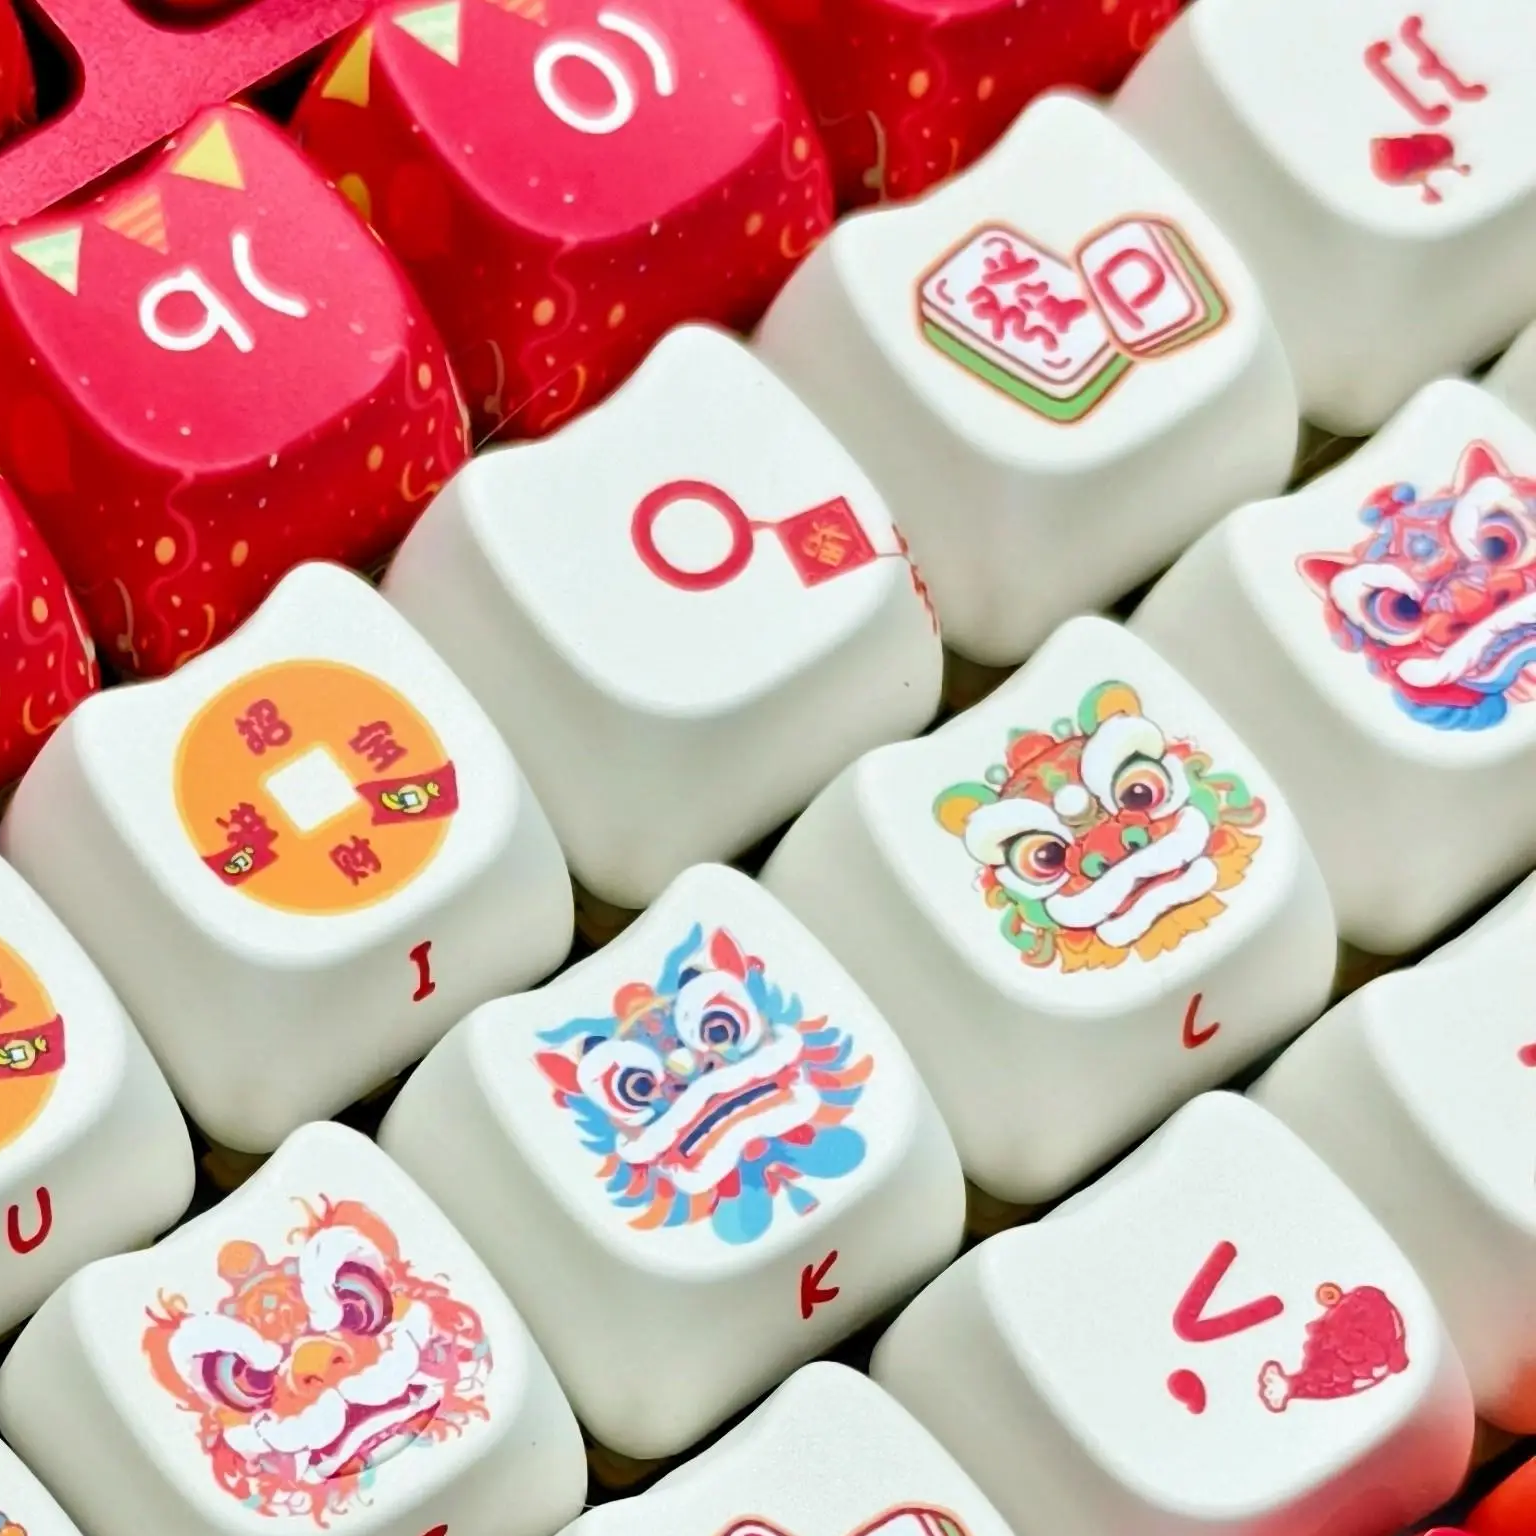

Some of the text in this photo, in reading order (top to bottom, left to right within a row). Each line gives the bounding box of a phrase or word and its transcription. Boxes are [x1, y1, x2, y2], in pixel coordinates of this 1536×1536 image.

[534, 12, 674, 134] 0)
[138, 232, 307, 352] 9(
[1094, 248, 1166, 332] P
[630, 480, 753, 591] O
[408, 941, 437, 1002] I
[1182, 993, 1220, 1049] L
[5, 1186, 53, 1255] U
[798, 1250, 839, 1319] K
